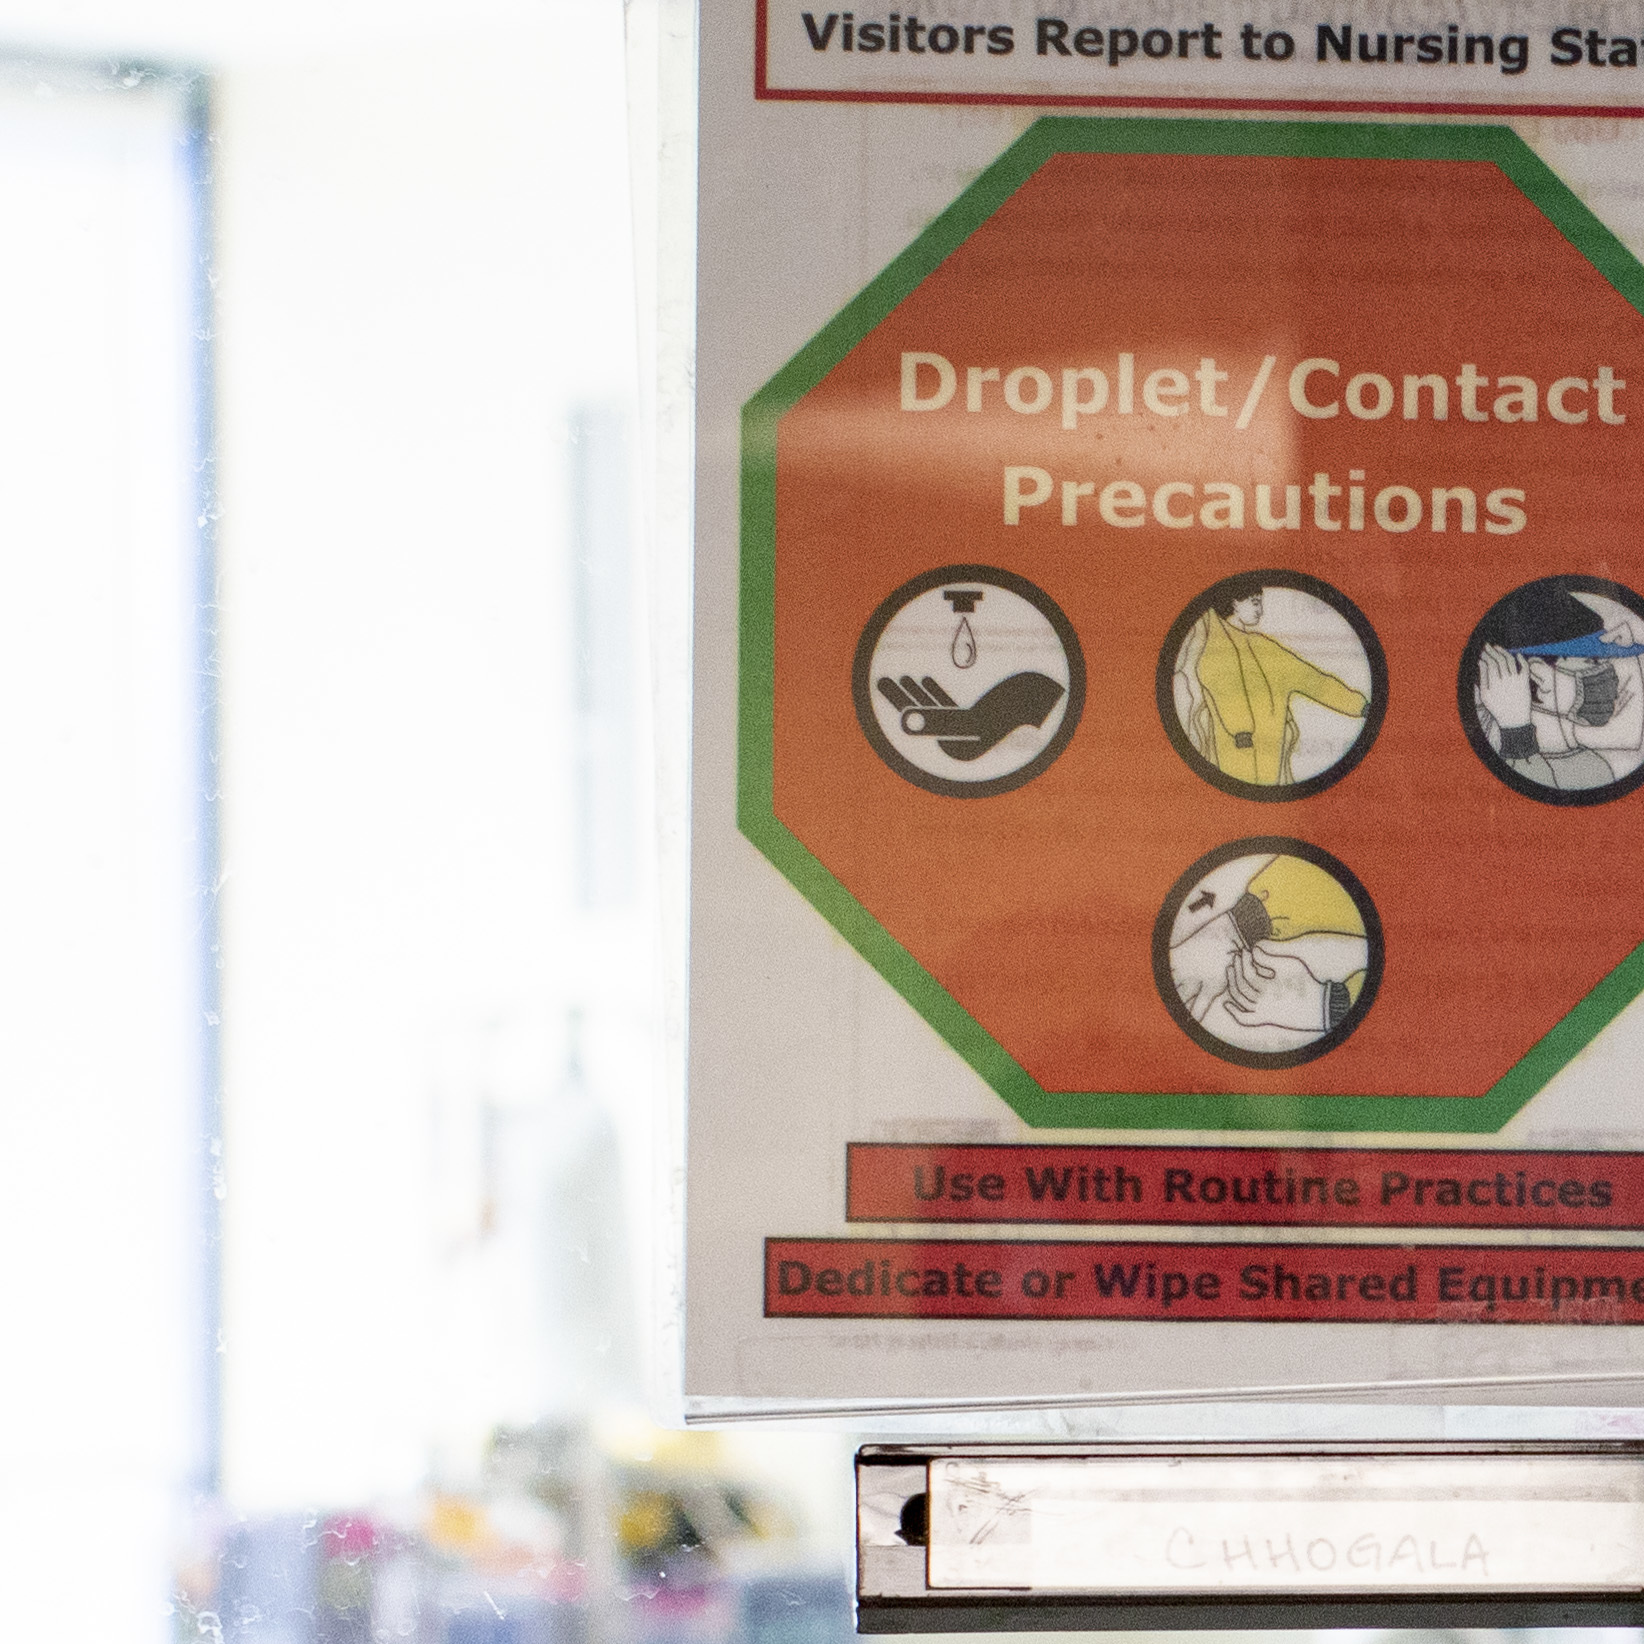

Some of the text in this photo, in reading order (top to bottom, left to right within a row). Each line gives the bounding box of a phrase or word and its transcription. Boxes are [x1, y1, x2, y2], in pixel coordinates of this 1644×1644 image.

[801, 12, 1015, 56] Visitors
[1035, 17, 1222, 67] Report
[1239, 22, 1296, 62] to
[1314, 23, 1530, 76] Nursing
[900, 351, 1627, 430] Droplet/Contact
[1003, 464, 1527, 535] Precautions
[914, 1163, 1615, 1211] Use With Routine Practices
[777, 1259, 1002, 1300] Dedicate
[1020, 1269, 1077, 1300] or
[1092, 1260, 1222, 1309] Wipe
[1238, 1262, 1419, 1303] Shared
[1164, 1525, 1491, 1577] CHHOGALA
